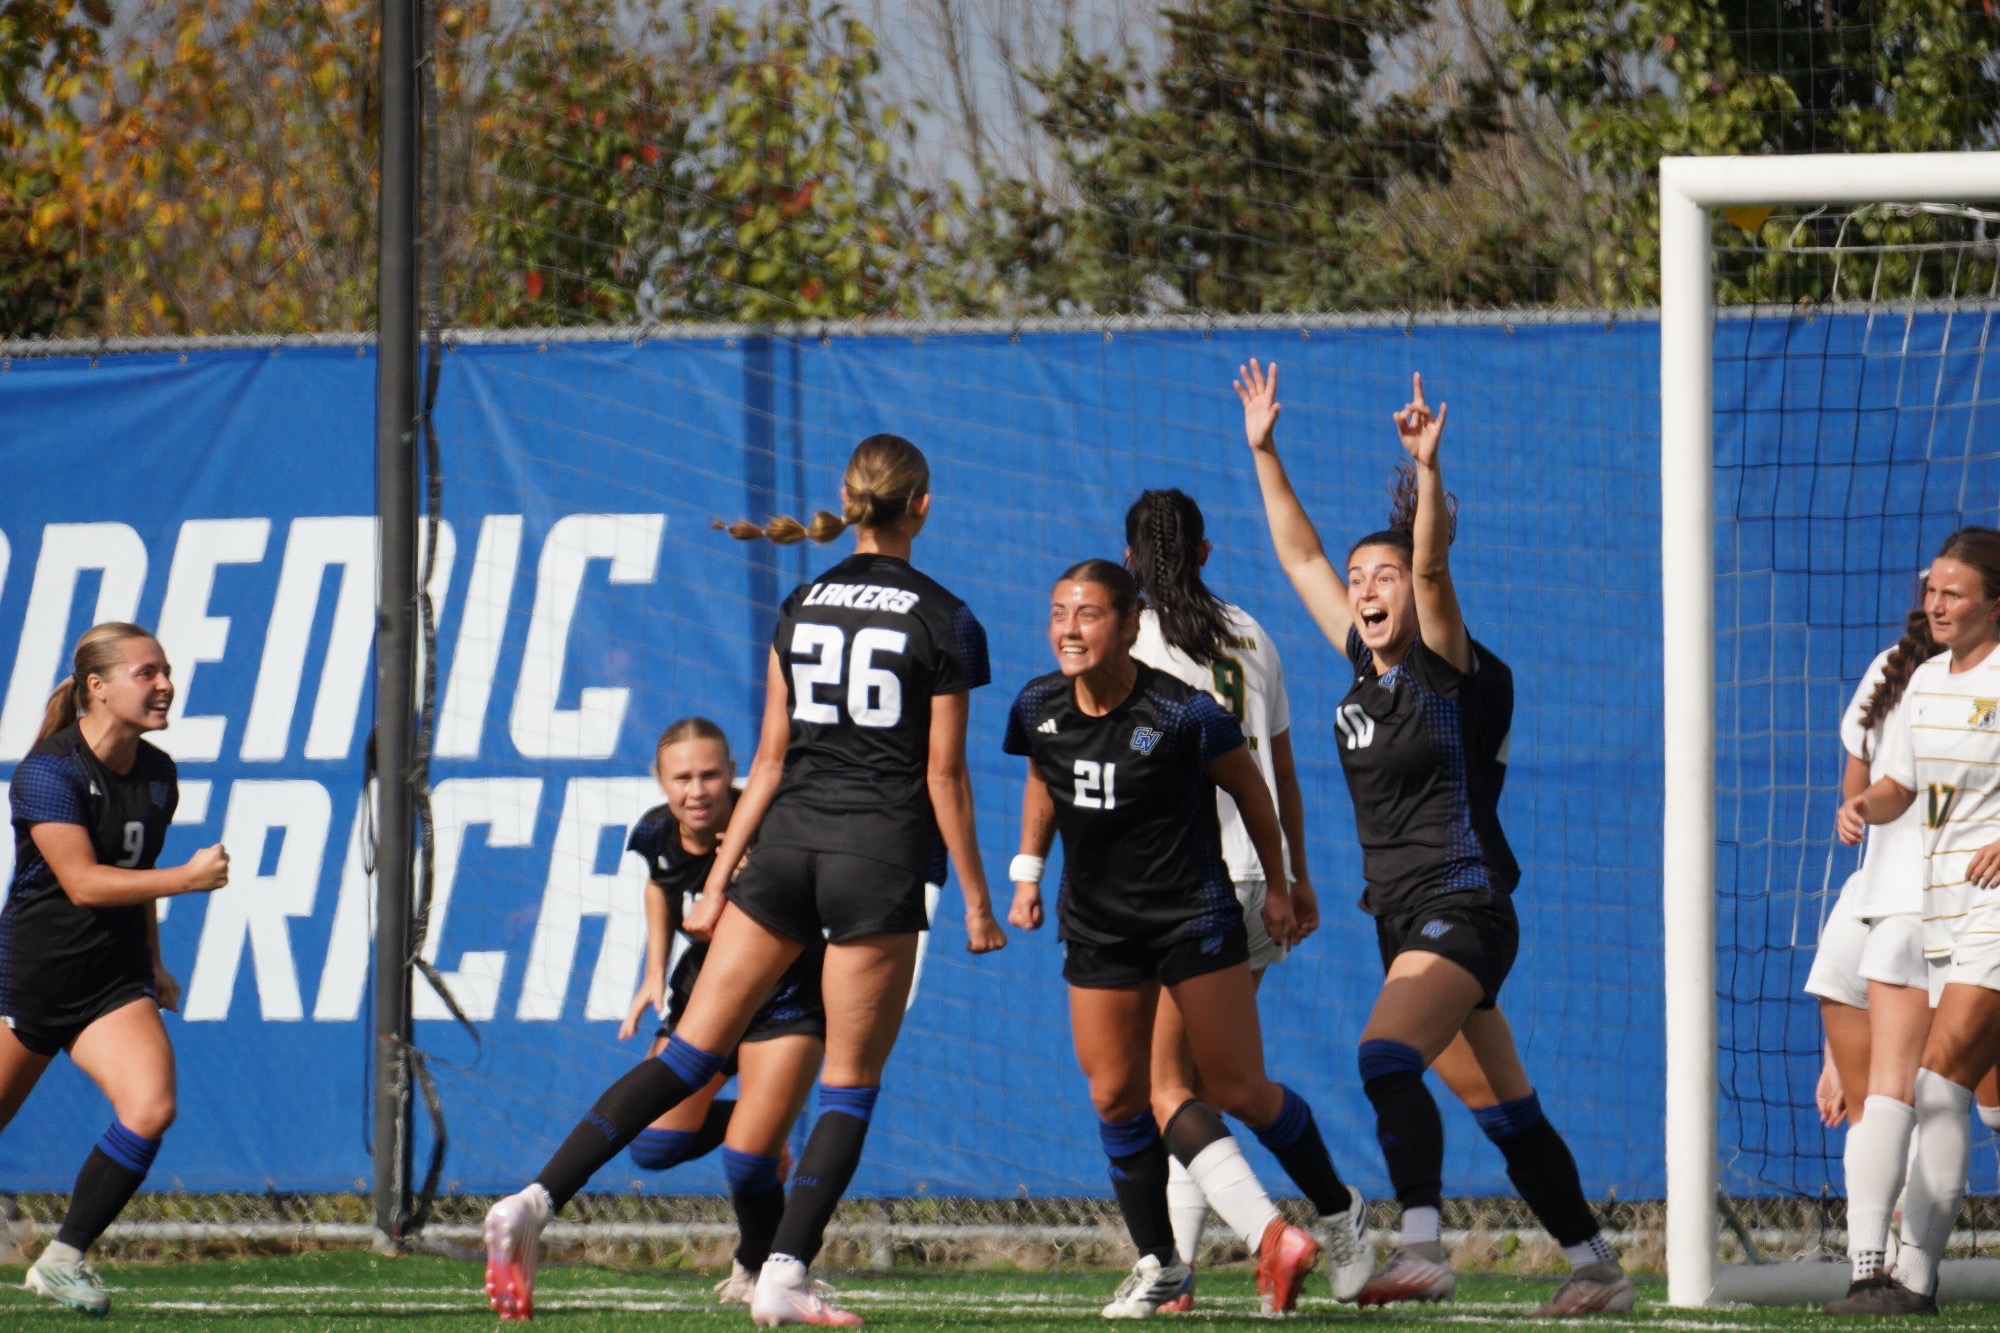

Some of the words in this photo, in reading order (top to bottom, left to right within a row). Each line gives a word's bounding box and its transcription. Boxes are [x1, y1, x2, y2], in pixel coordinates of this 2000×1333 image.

[801, 582, 920, 614] LAKERS
[0, 513, 667, 764] DEMIC
[790, 622, 909, 729] 26
[1211, 655, 1246, 725] 9
[1129, 726, 1164, 755] GV
[1336, 703, 1375, 750] 10
[1073, 759, 1116, 810] 21
[1928, 783, 1957, 829] 17
[115, 820, 145, 868] 9
